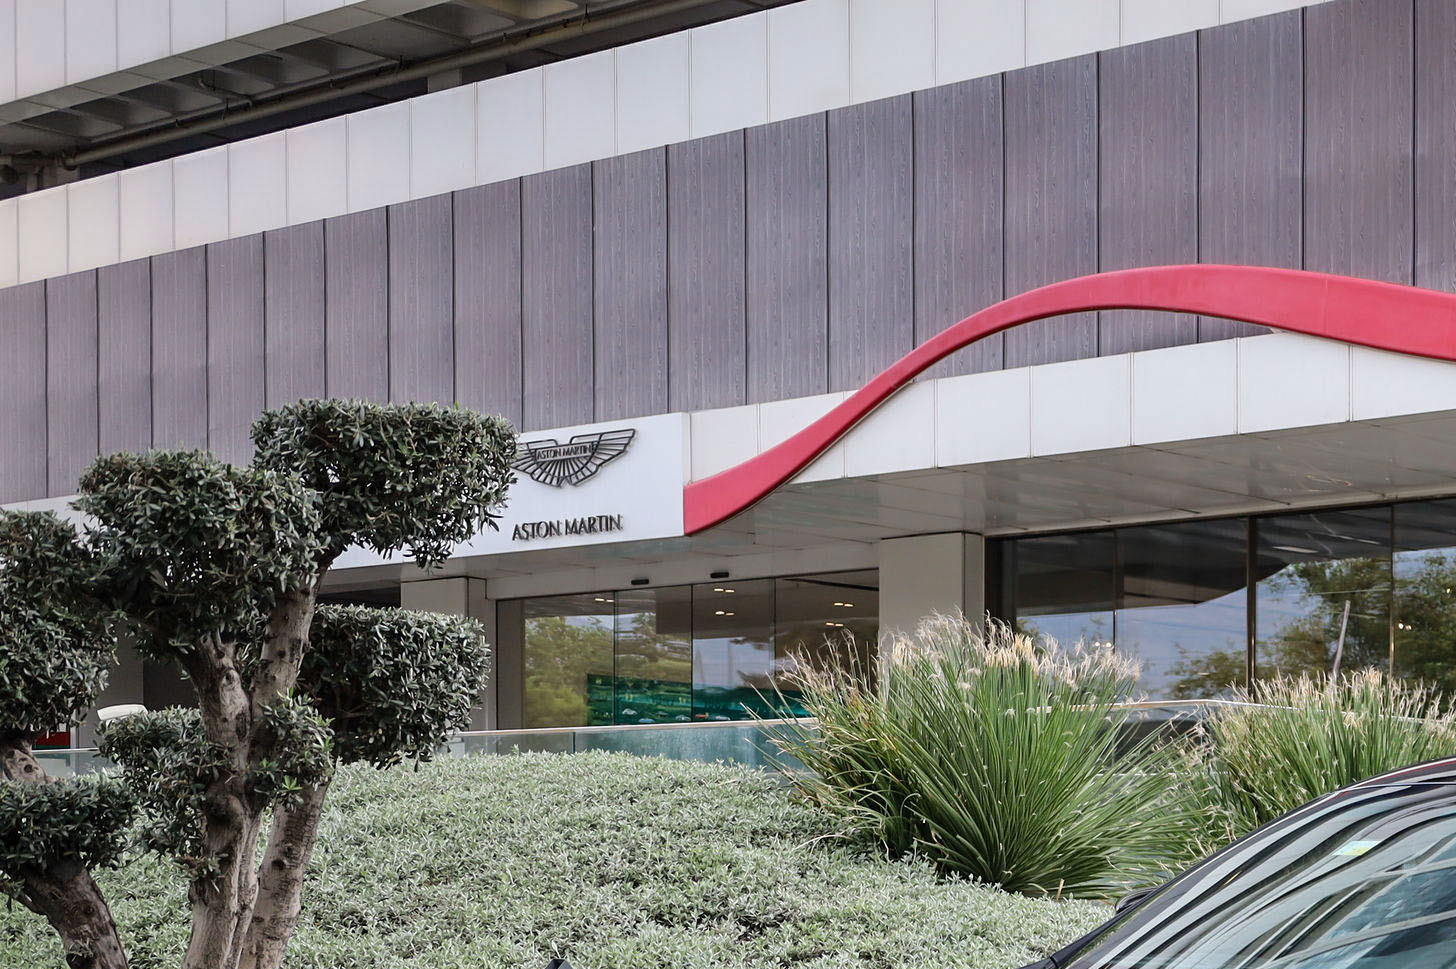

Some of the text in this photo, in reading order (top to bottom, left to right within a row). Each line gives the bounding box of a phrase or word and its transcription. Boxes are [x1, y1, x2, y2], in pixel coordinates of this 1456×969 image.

[537, 443, 593, 460] ASTON MARTIN
[511, 513, 622, 541] ASTON MARTIN
